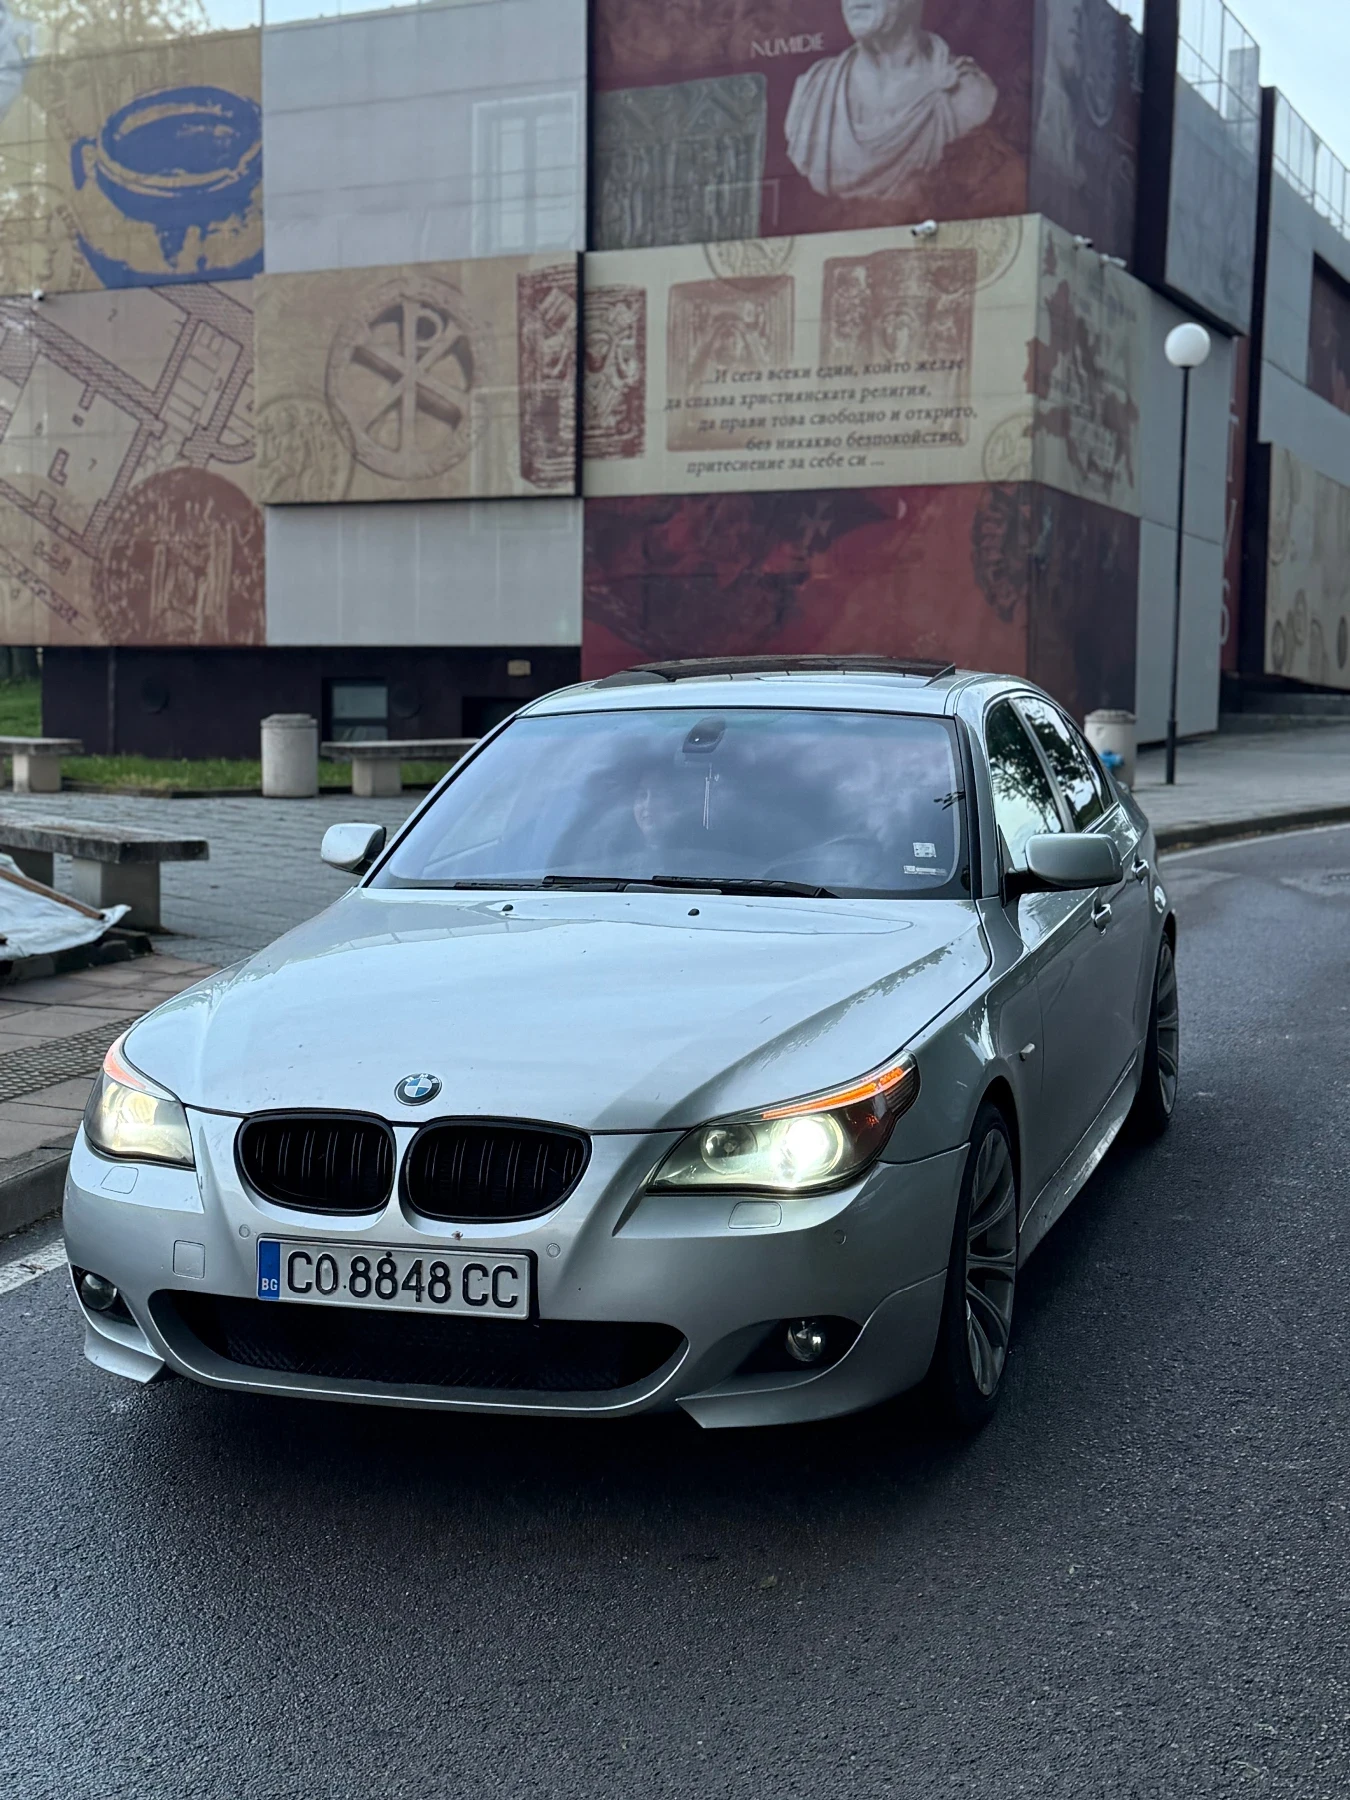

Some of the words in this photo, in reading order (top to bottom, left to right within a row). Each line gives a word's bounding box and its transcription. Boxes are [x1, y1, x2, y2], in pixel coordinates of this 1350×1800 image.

[731, 370, 763, 384] сега
[767, 367, 812, 382] всеки
[863, 358, 911, 376] който
[684, 395, 736, 410] спазва
[739, 387, 856, 411] християнската
[698, 418, 717, 433] да
[720, 416, 767, 435] прави
[771, 414, 806, 429] това
[809, 407, 887, 427] свободно
[890, 408, 901, 422] и
[745, 435, 772, 451] без
[775, 435, 843, 451] никакво
[787, 457, 806, 470] за
[808, 451, 845, 469] себе
[847, 454, 868, 468] си
[261, 1276, 279, 1292] BG
